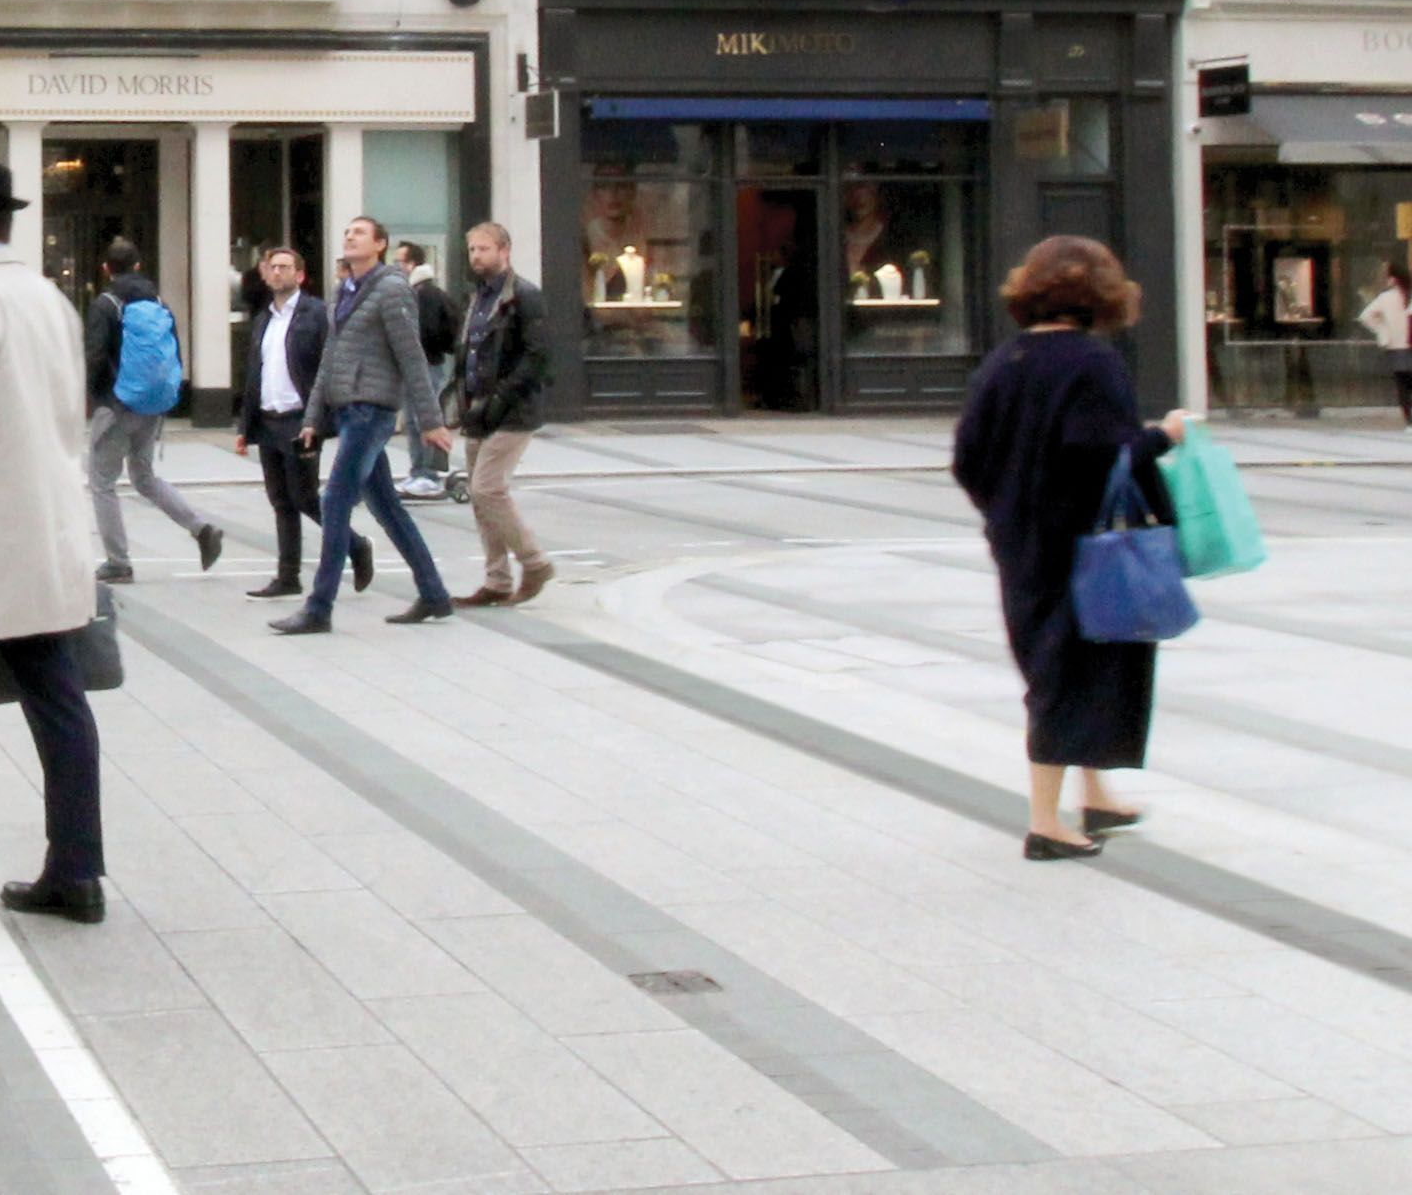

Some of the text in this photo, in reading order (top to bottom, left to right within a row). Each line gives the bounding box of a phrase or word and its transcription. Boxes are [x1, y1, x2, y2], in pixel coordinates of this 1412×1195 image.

[716, 32, 854, 55] MIKIMOTO
[28, 73, 214, 97] DAVID MORRIS
